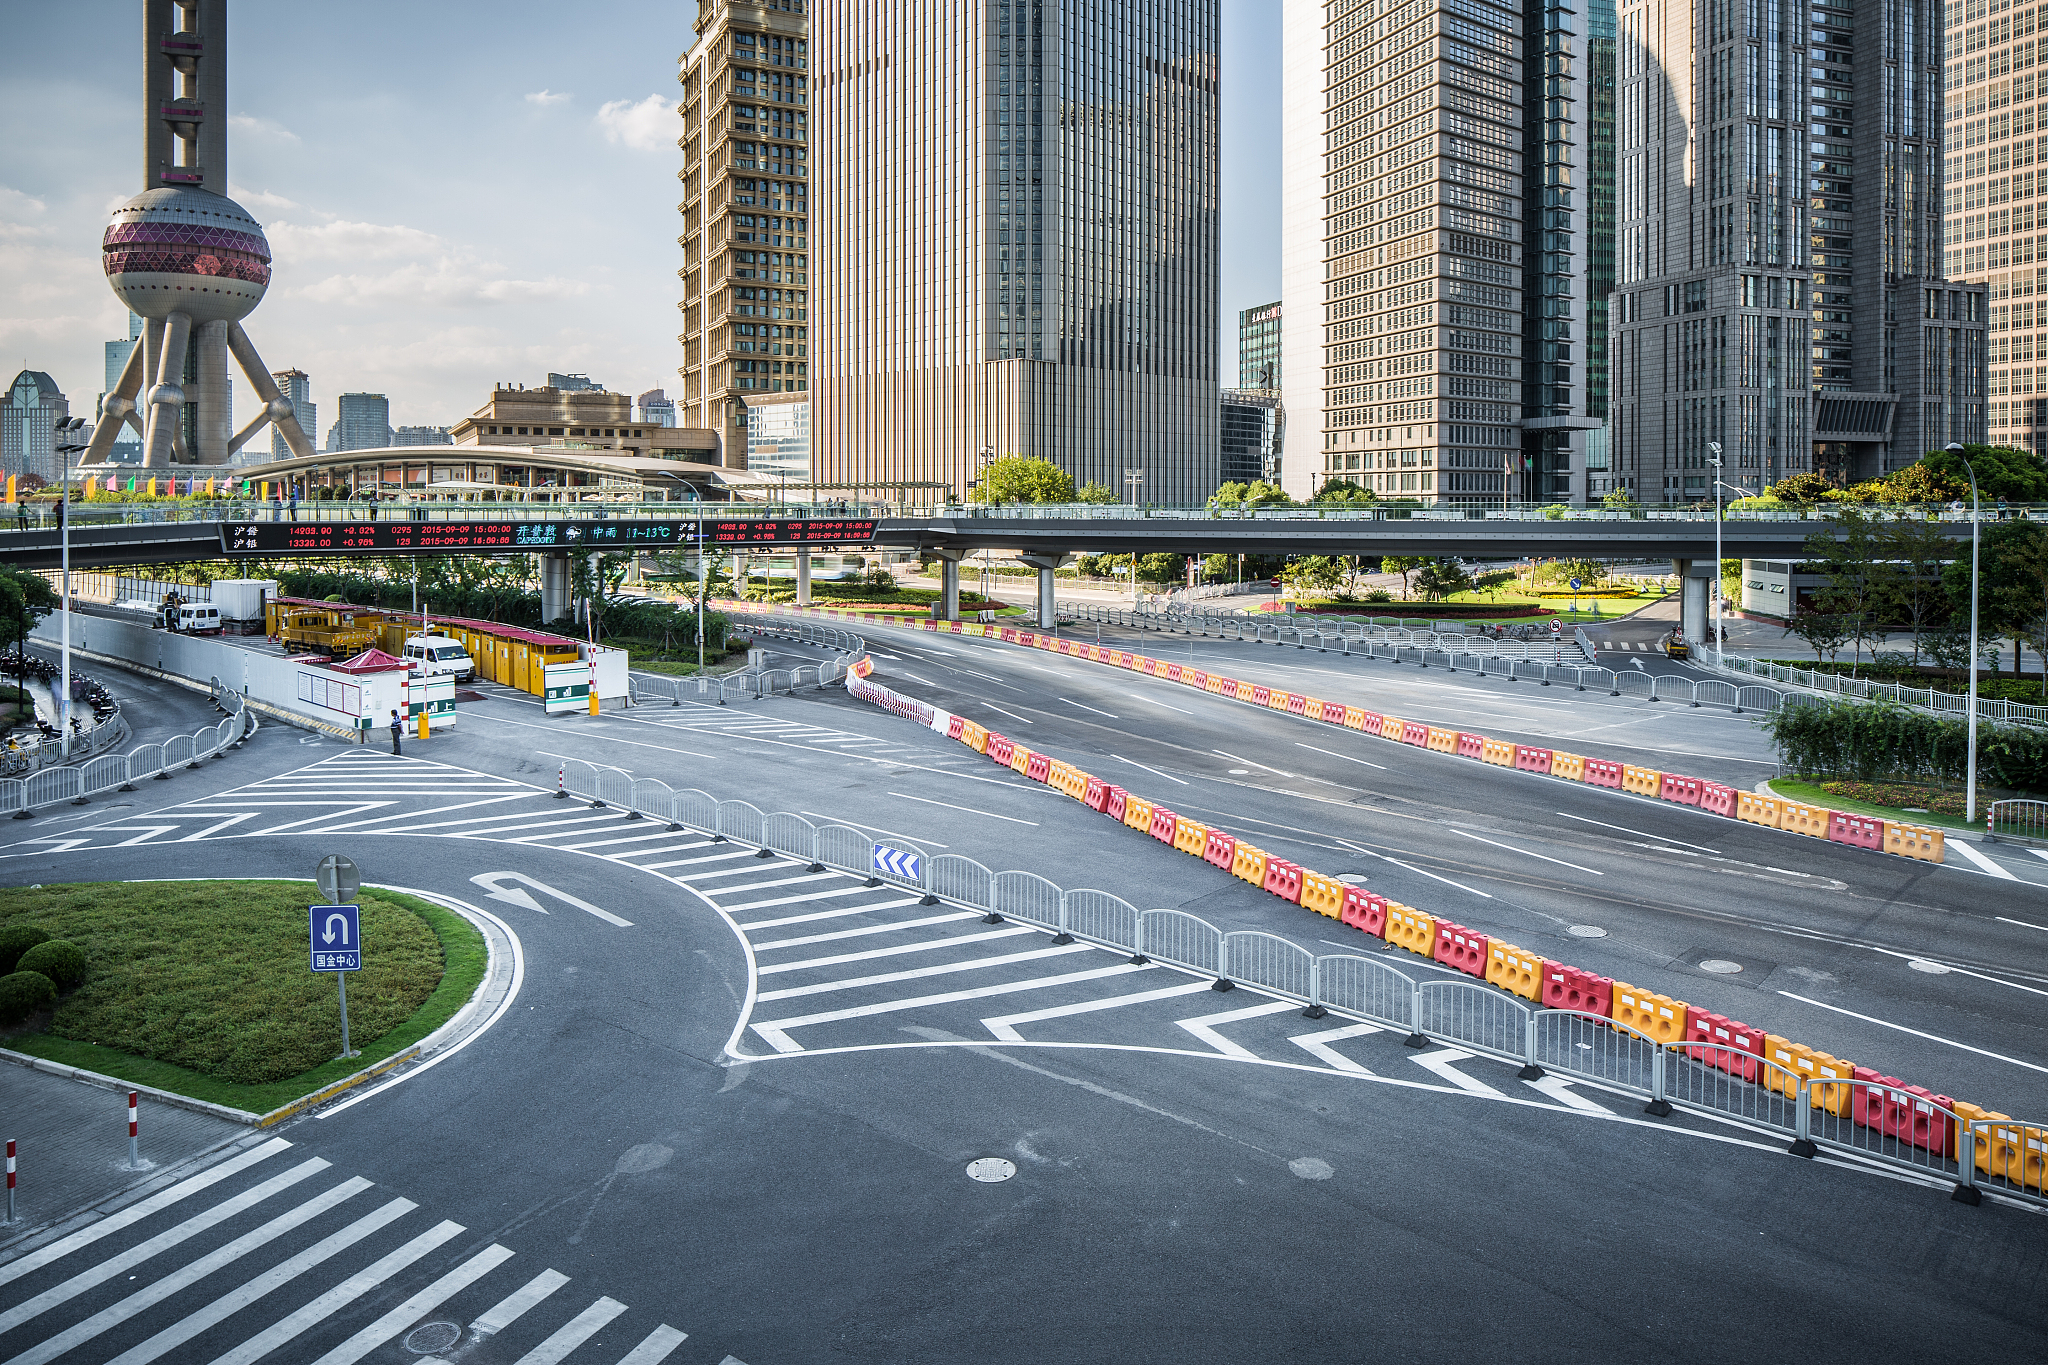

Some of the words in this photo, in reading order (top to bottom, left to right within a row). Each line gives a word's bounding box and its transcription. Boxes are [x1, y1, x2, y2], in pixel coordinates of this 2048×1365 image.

[422, 526, 470, 534] 2015-09-09
[593, 526, 618, 538] 中雨
[316, 954, 356, 967] 国金中心
